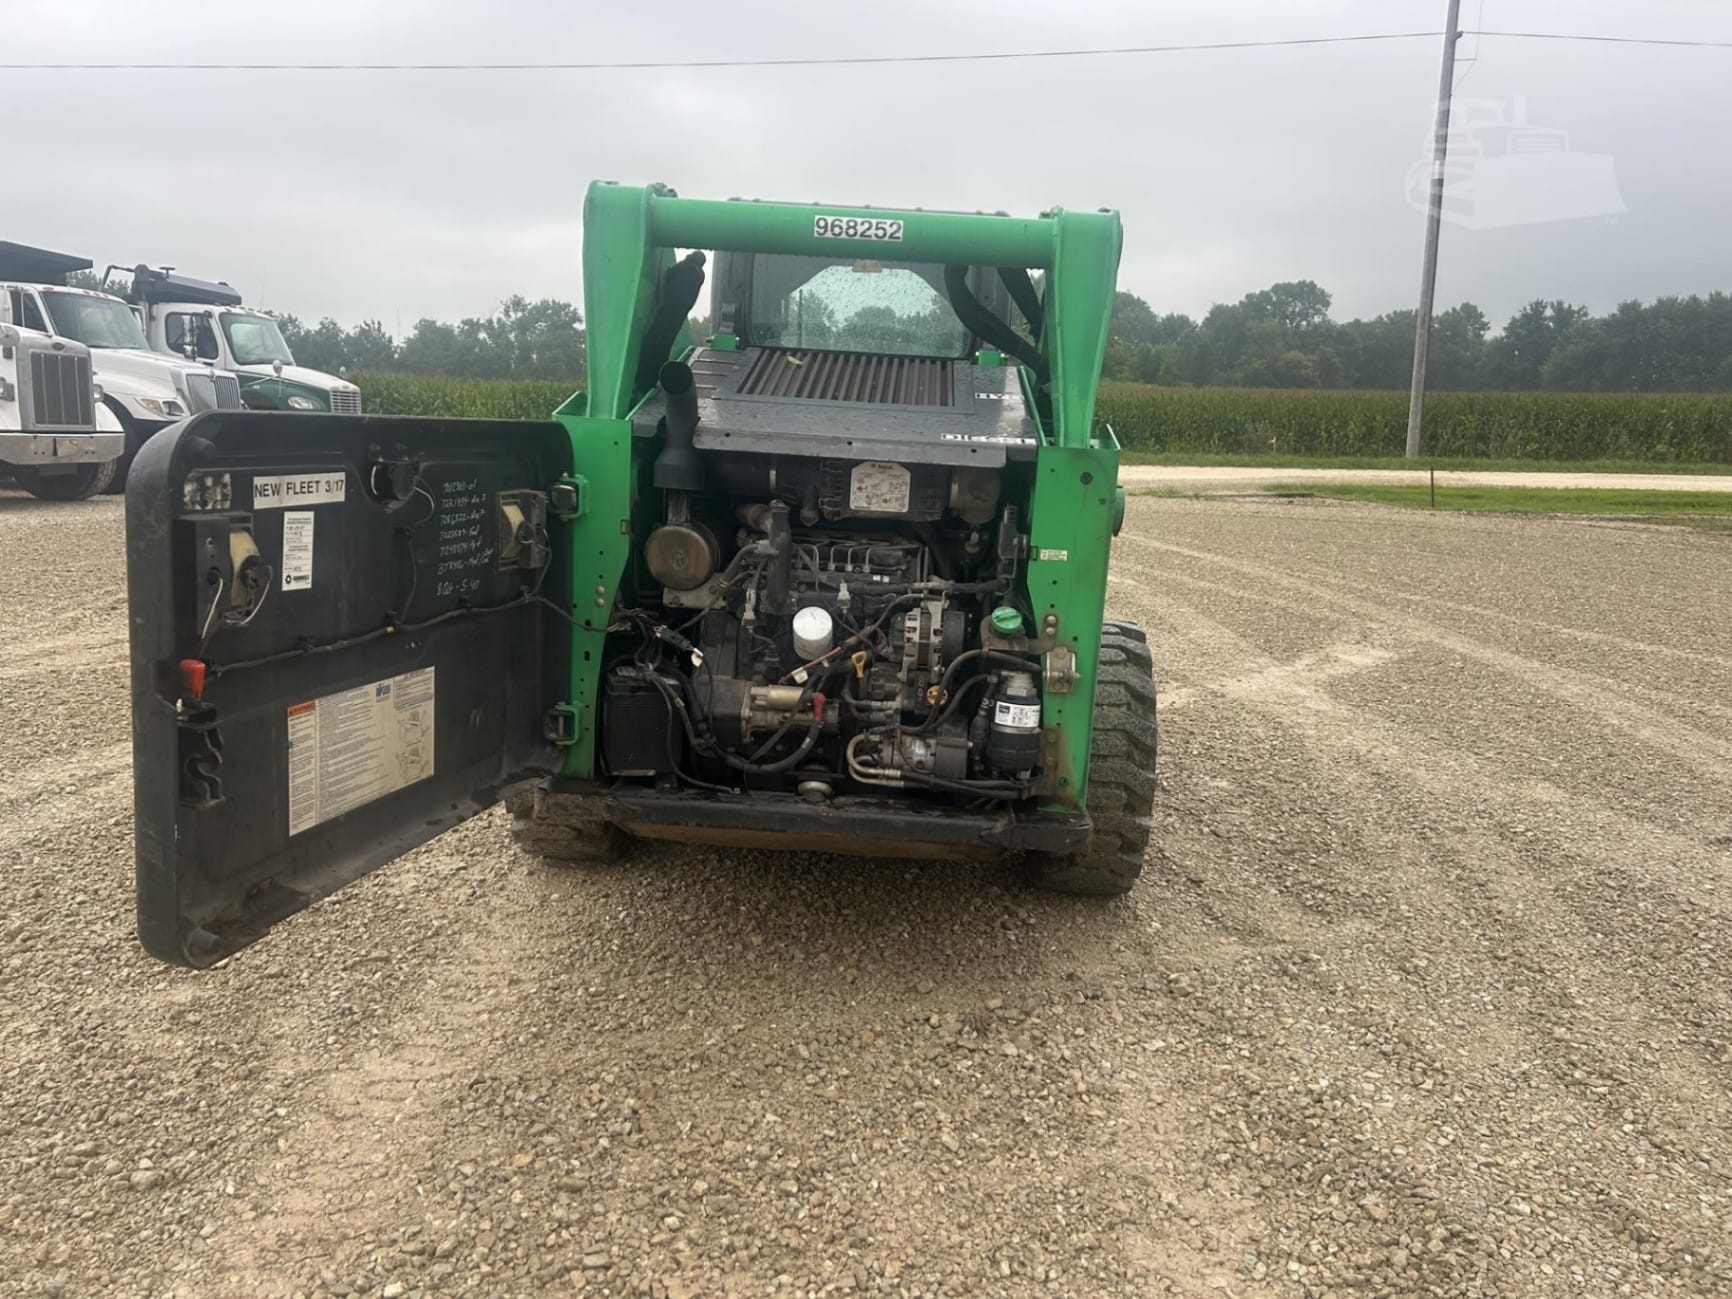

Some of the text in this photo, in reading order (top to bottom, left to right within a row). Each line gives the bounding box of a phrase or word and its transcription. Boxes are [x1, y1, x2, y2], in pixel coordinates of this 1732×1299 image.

[815, 217, 902, 240] 968252
[254, 479, 344, 498] NEW FLEET 3/17
